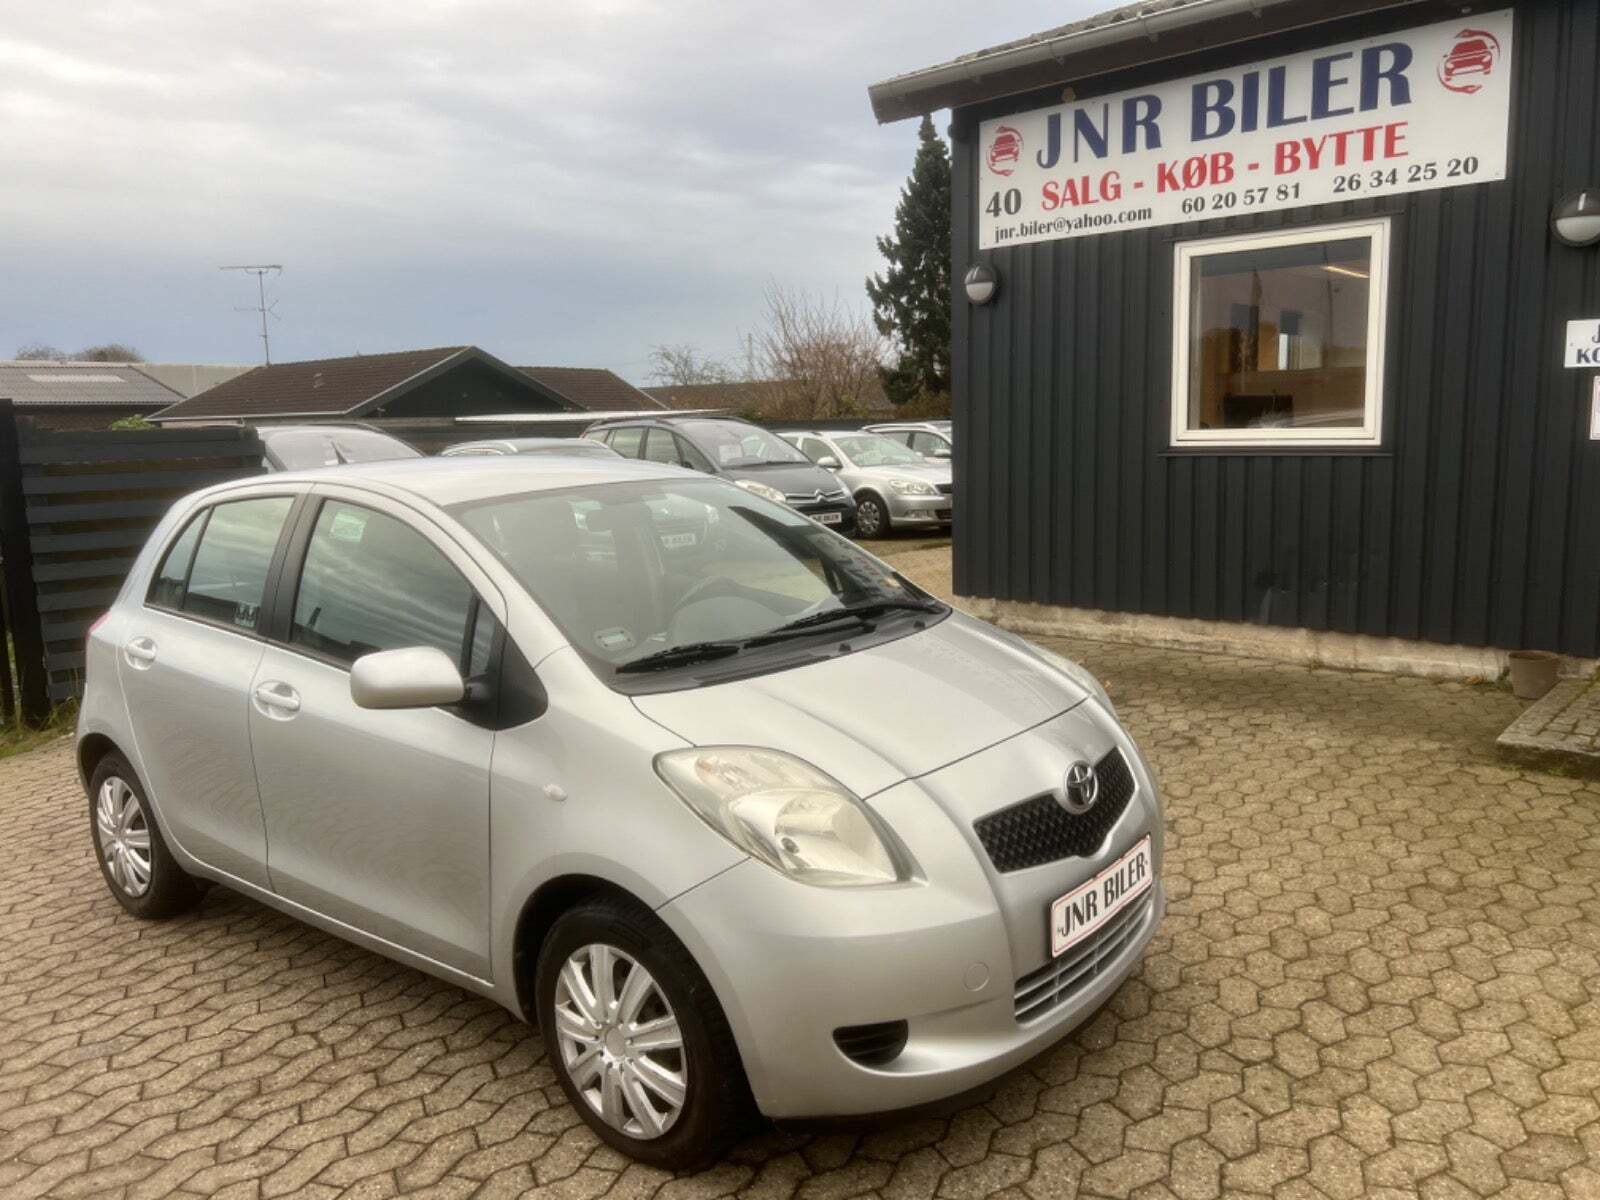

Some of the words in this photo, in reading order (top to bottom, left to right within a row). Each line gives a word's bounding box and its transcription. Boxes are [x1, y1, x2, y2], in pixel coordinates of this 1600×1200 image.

[1036, 94, 1162, 169] JNR
[1191, 42, 1413, 142] BILER
[1041, 170, 1121, 211] SALG
[1133, 181, 1144, 189] -
[1157, 151, 1234, 193] KØB
[1248, 162, 1259, 171] -
[1274, 121, 1408, 176] BYTTE
[1333, 173, 1361, 193] 26
[1369, 168, 1398, 188] 34
[1408, 162, 1437, 183] 25
[1446, 156, 1479, 178] 20
[985, 188, 1022, 218] 40
[1182, 197, 1206, 214] 60
[1211, 191, 1237, 210] 20
[1243, 187, 1269, 206] 57
[1276, 182, 1300, 201] 81
[994, 207, 1152, 244] jnr.biler@yahoo.com
[1060, 889, 1098, 937] JNR
[1104, 851, 1146, 910] BILER
